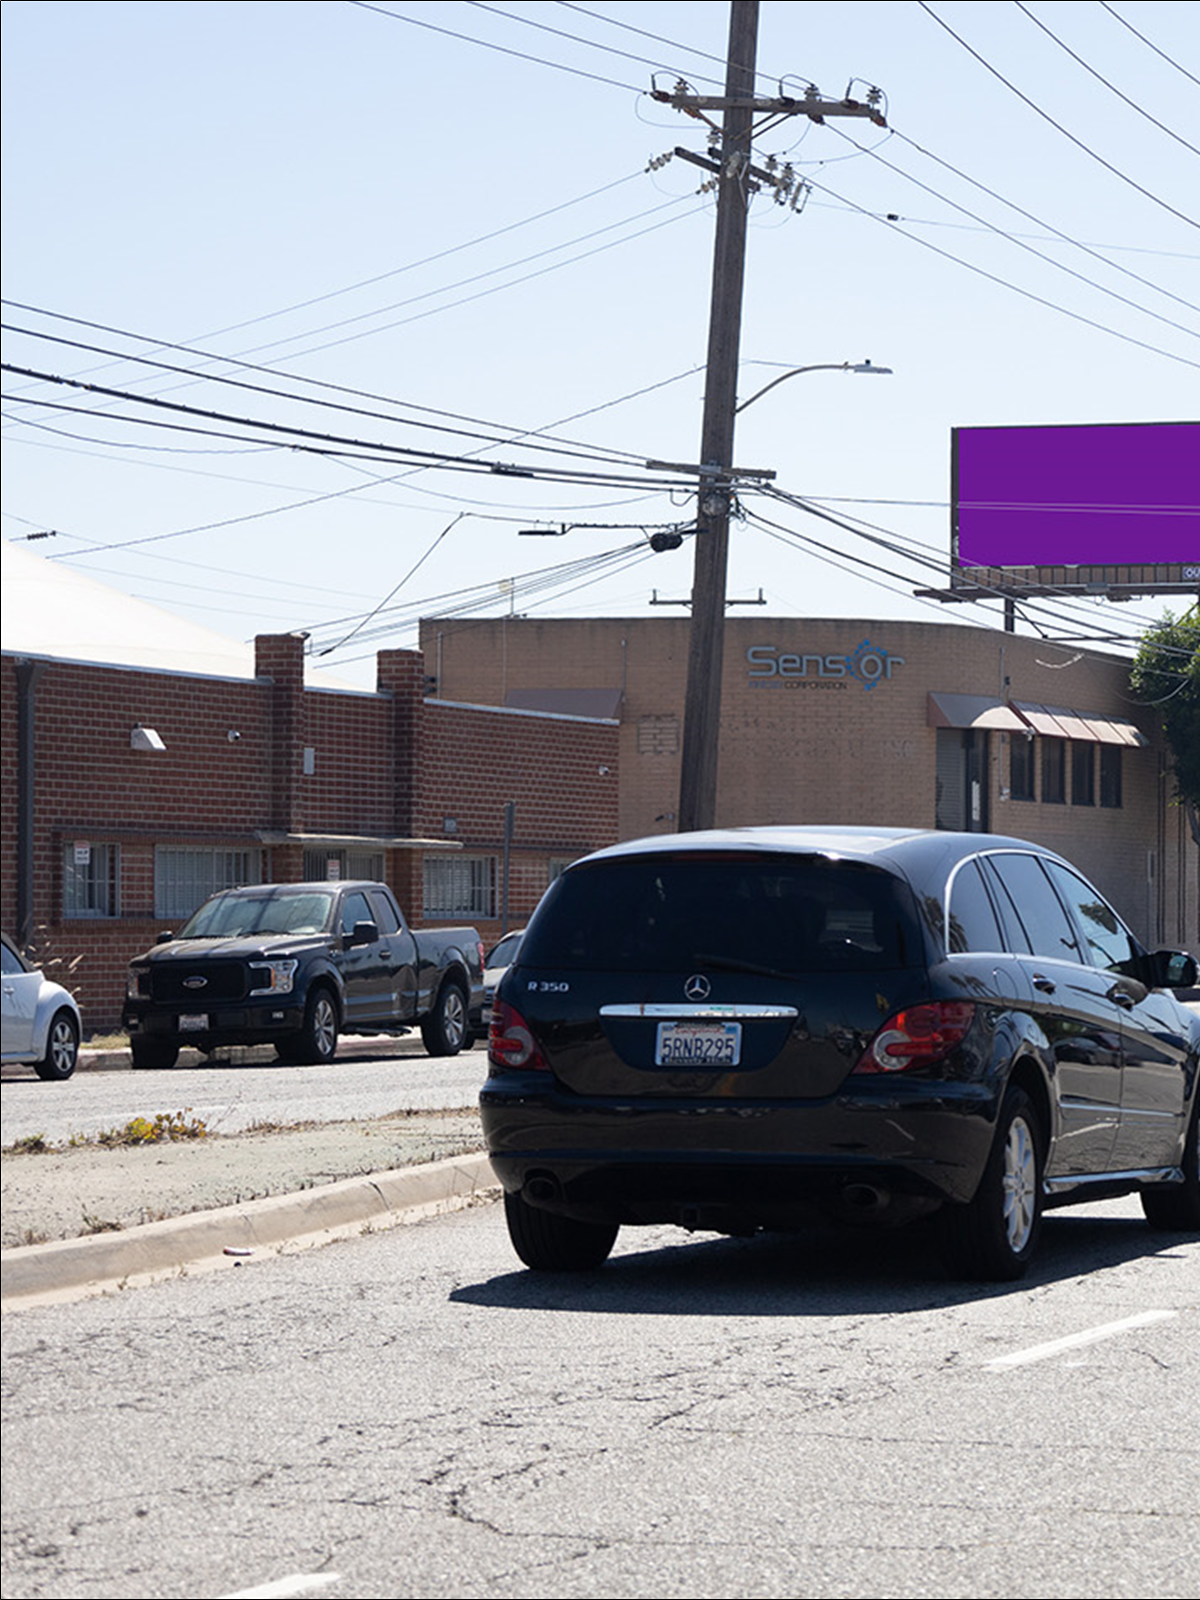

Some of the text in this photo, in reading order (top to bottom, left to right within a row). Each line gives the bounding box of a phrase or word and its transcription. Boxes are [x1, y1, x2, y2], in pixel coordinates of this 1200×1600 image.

[746, 646, 905, 679] Sensor
[785, 681, 847, 690] CORPORATION
[527, 981, 569, 992] R 350
[661, 1037, 735, 1060] 5RNB295
